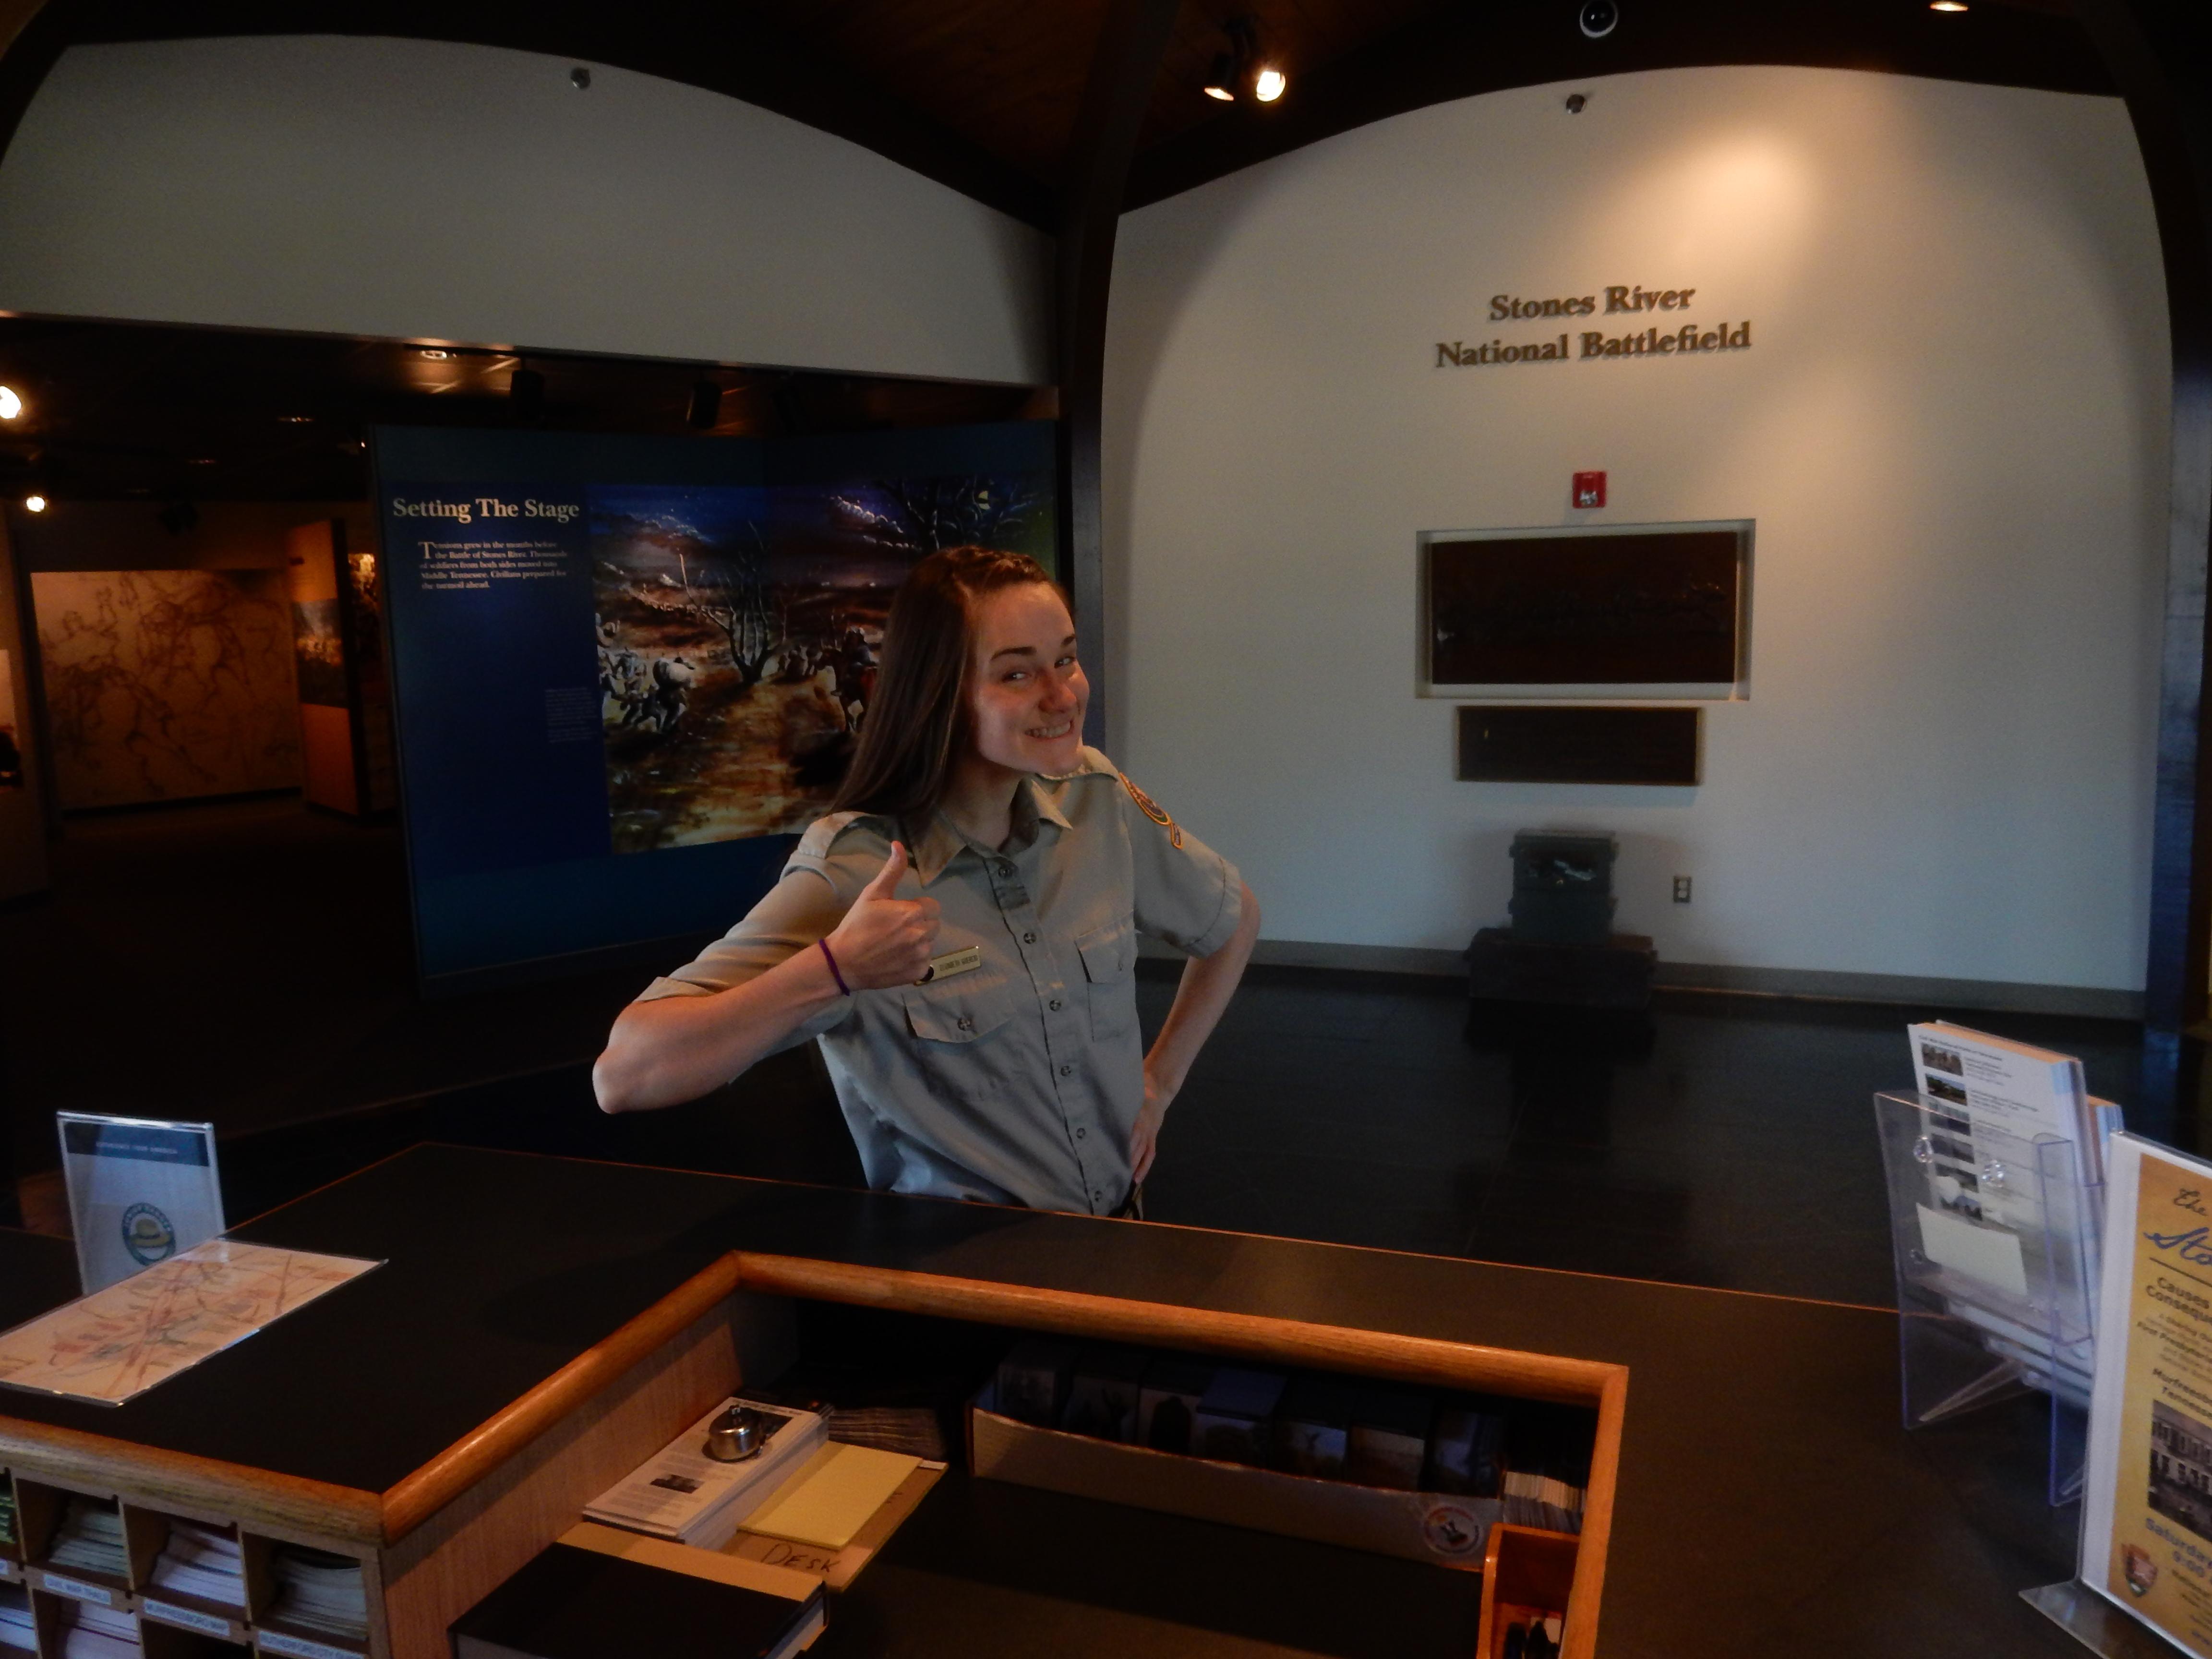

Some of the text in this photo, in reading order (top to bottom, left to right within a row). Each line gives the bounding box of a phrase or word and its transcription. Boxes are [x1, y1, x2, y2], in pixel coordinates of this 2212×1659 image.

[1489, 285, 1695, 320] Stones River
[1436, 320, 1751, 368] National Battlefield
[393, 497, 580, 524] Setting The Stage
[2157, 1277, 2210, 1309] Causes
